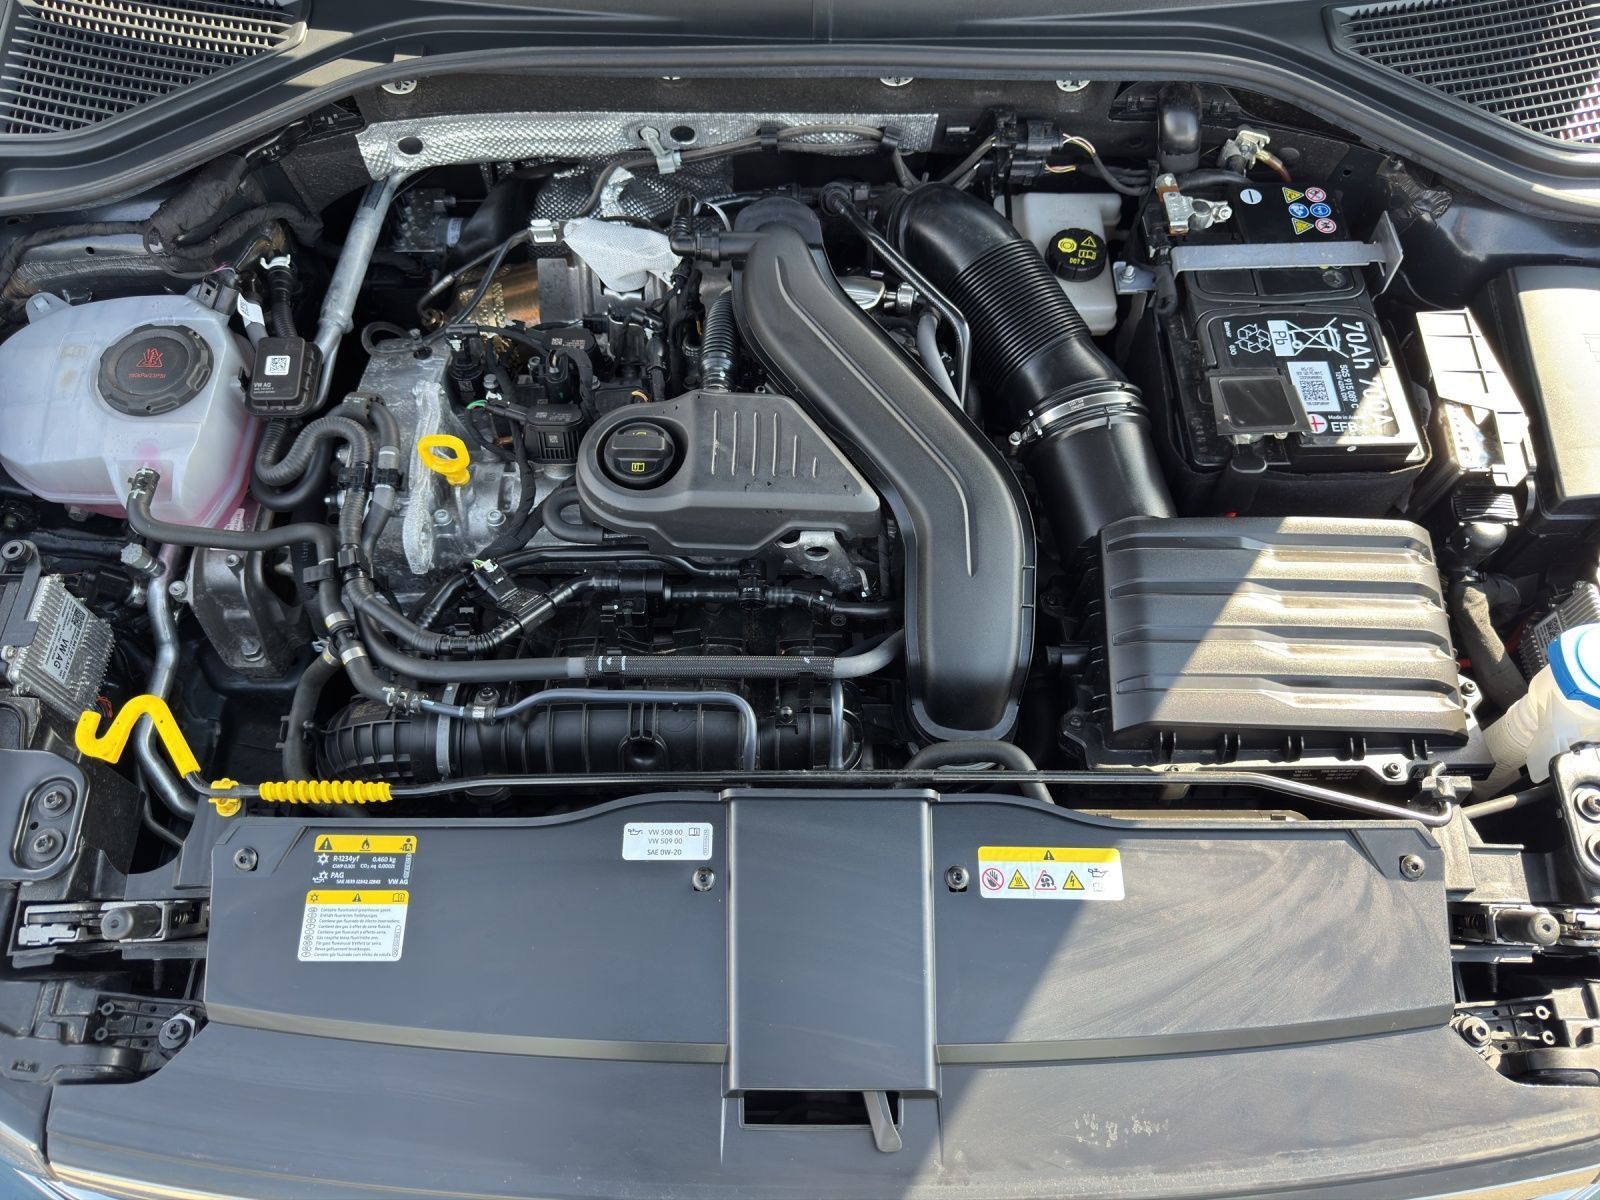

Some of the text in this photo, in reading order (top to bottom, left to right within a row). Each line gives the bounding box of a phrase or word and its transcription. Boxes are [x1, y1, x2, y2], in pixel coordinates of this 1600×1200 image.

[1272, 331, 1288, 345] Pb
[1342, 322, 1374, 369] 70Ah
[1344, 378, 1354, 390] 915
[59, 639, 69, 652] VW
[54, 655, 63, 669] AG
[333, 855, 360, 863] R-1234yf
